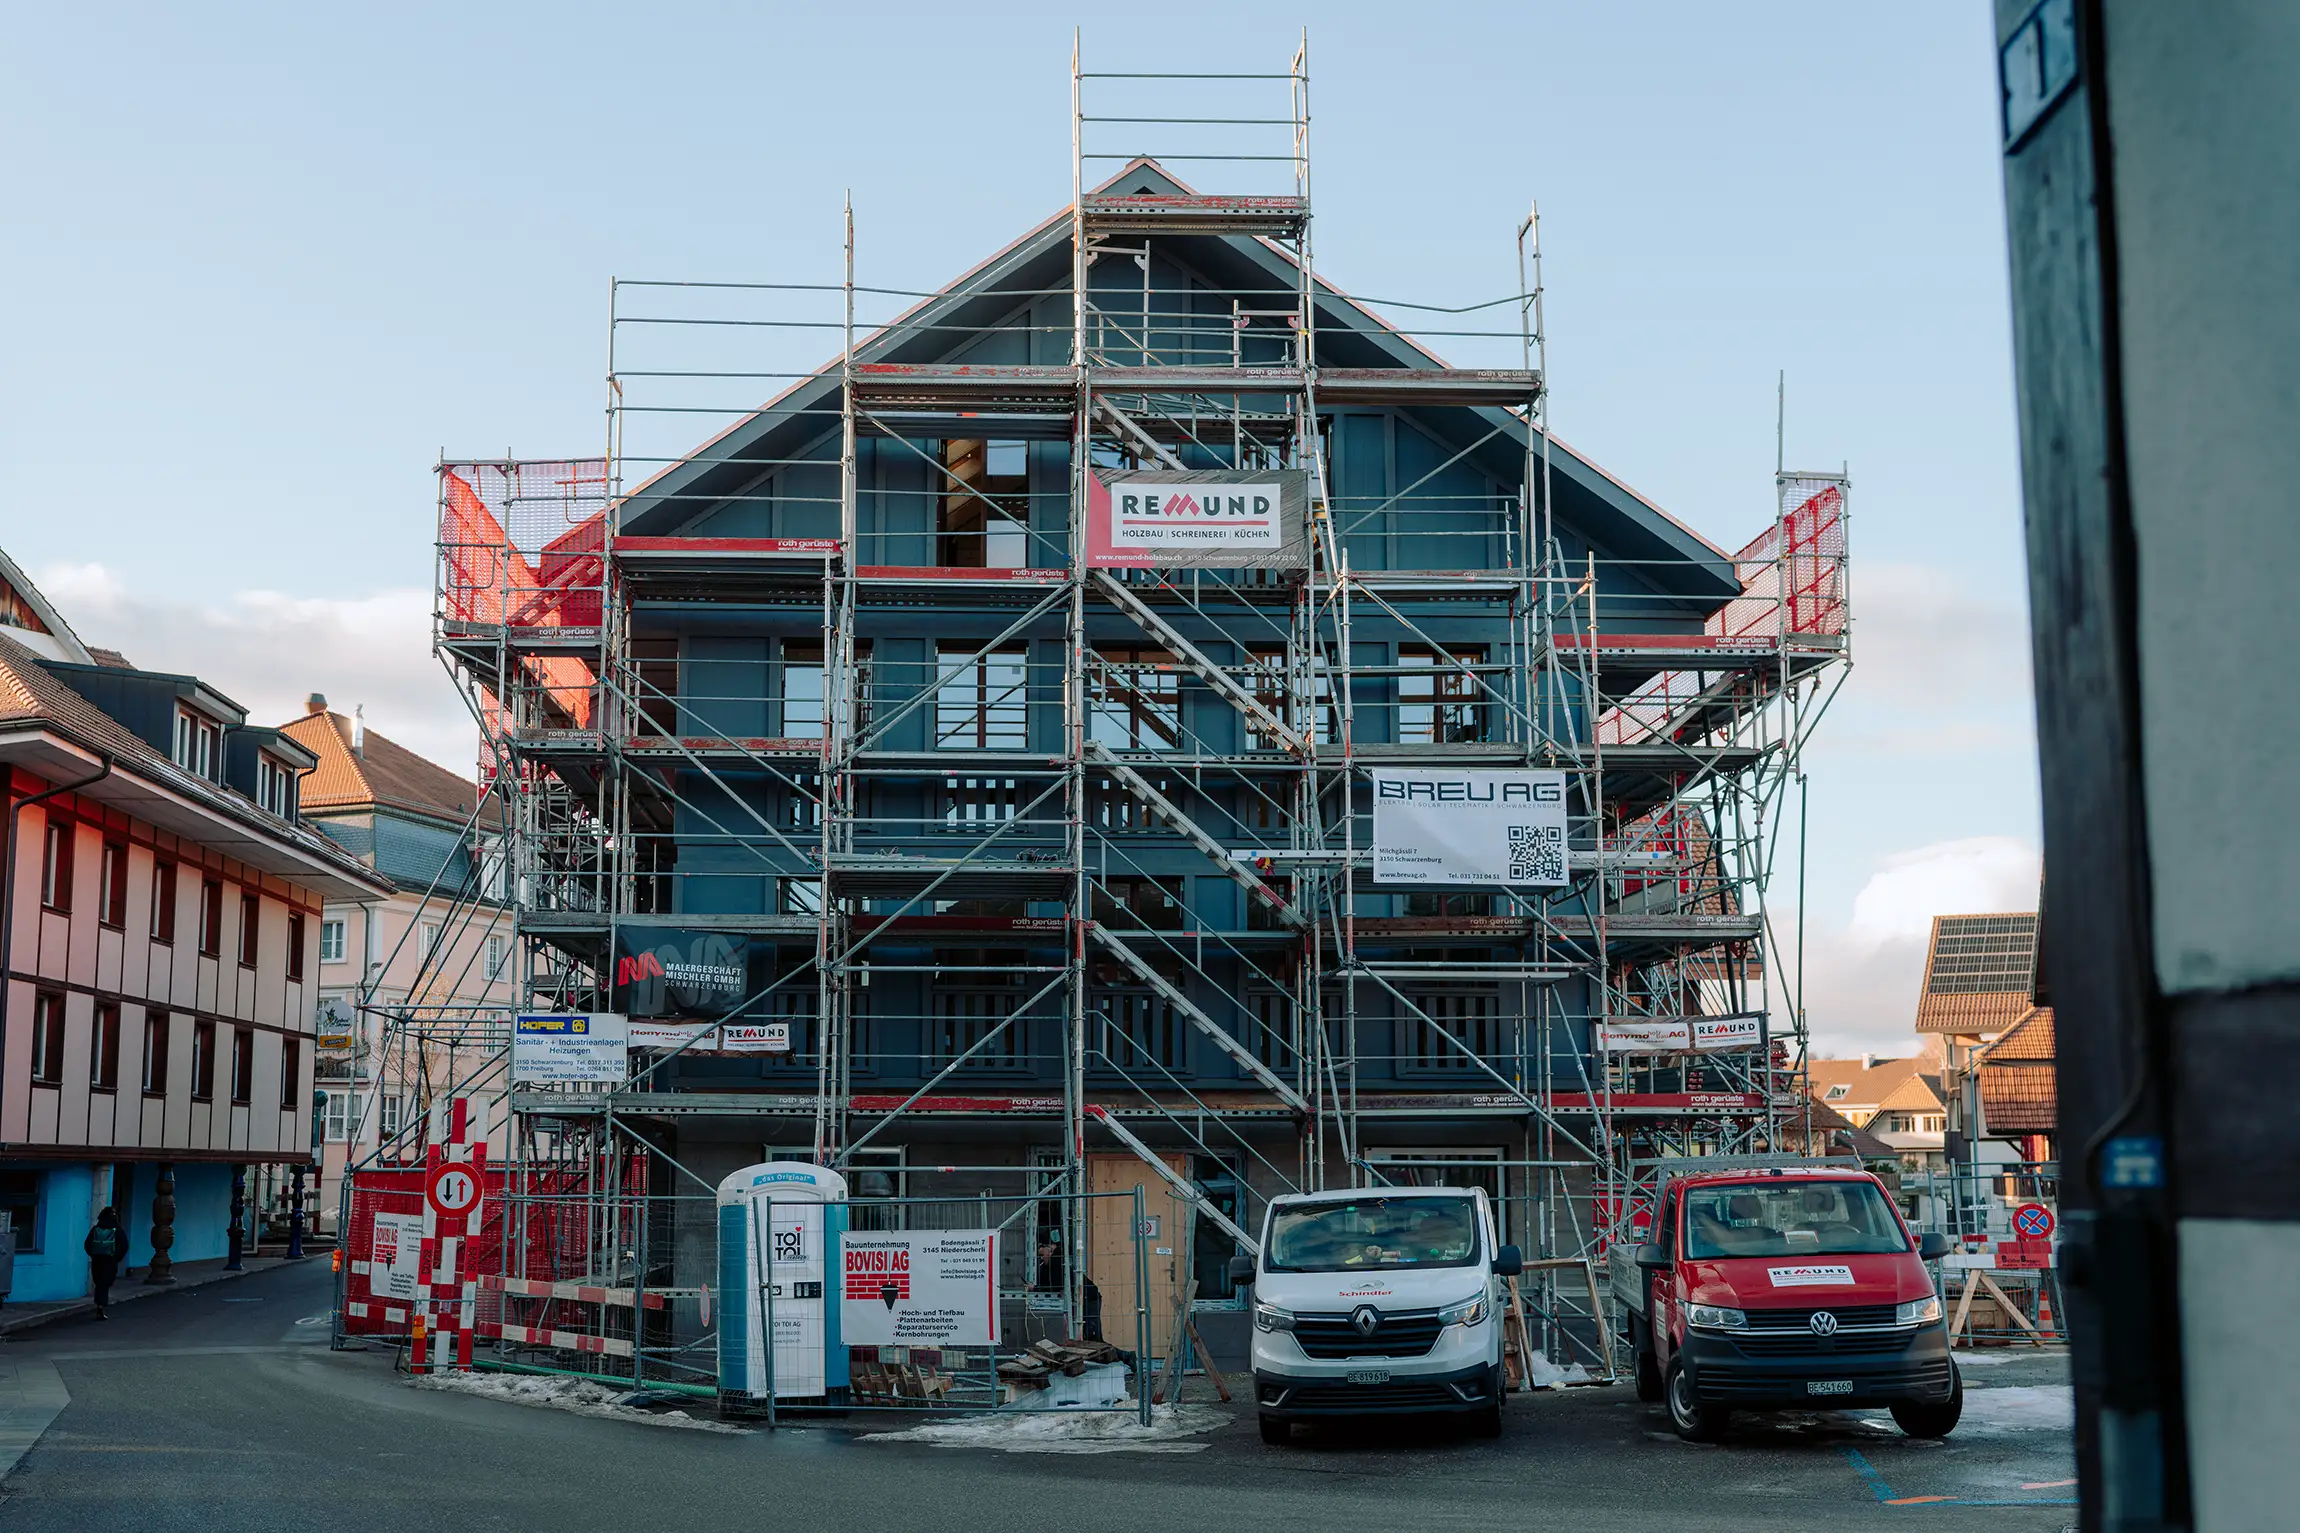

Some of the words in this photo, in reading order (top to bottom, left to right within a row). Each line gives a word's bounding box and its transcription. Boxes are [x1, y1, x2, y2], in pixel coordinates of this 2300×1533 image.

[1122, 493, 1270, 517] REMUND
[1122, 530, 1164, 538] HOLZBAU
[1171, 530, 1227, 538] SCHREINEREI
[1234, 528, 1270, 538] KÜCHEN
[1095, 553, 1183, 562] www.remund-holzbau.ch
[1379, 780, 1494, 802] BREU
[1503, 782, 1561, 802] AG
[1395, 856, 1442, 864] Schwarzenburg
[666, 962, 742, 976] MALERGESCHÄFT
[665, 971, 711, 982] MISCHLER
[714, 974, 741, 985] GMBH
[664, 979, 740, 992] SCHWARZENBURG
[520, 1021, 566, 1030] HOFER
[1698, 1022, 1756, 1034] REMUND
[630, 1029, 679, 1037] Honymo
[728, 1028, 785, 1039] REMUND
[1668, 1030, 1686, 1038] AG
[558, 1038, 624, 1046] Industrieanlagen
[549, 1047, 591, 1056] Heizungen
[542, 1072, 598, 1080] www.hofer-ag.ch
[1710, 1094, 1744, 1104] gerüste
[774, 1232, 800, 1246] TOI
[845, 1241, 910, 1250] Bauunternehmung
[846, 1251, 888, 1272] BOVISI
[891, 1251, 910, 1272] AG
[1772, 1268, 1846, 1276] REMUND
